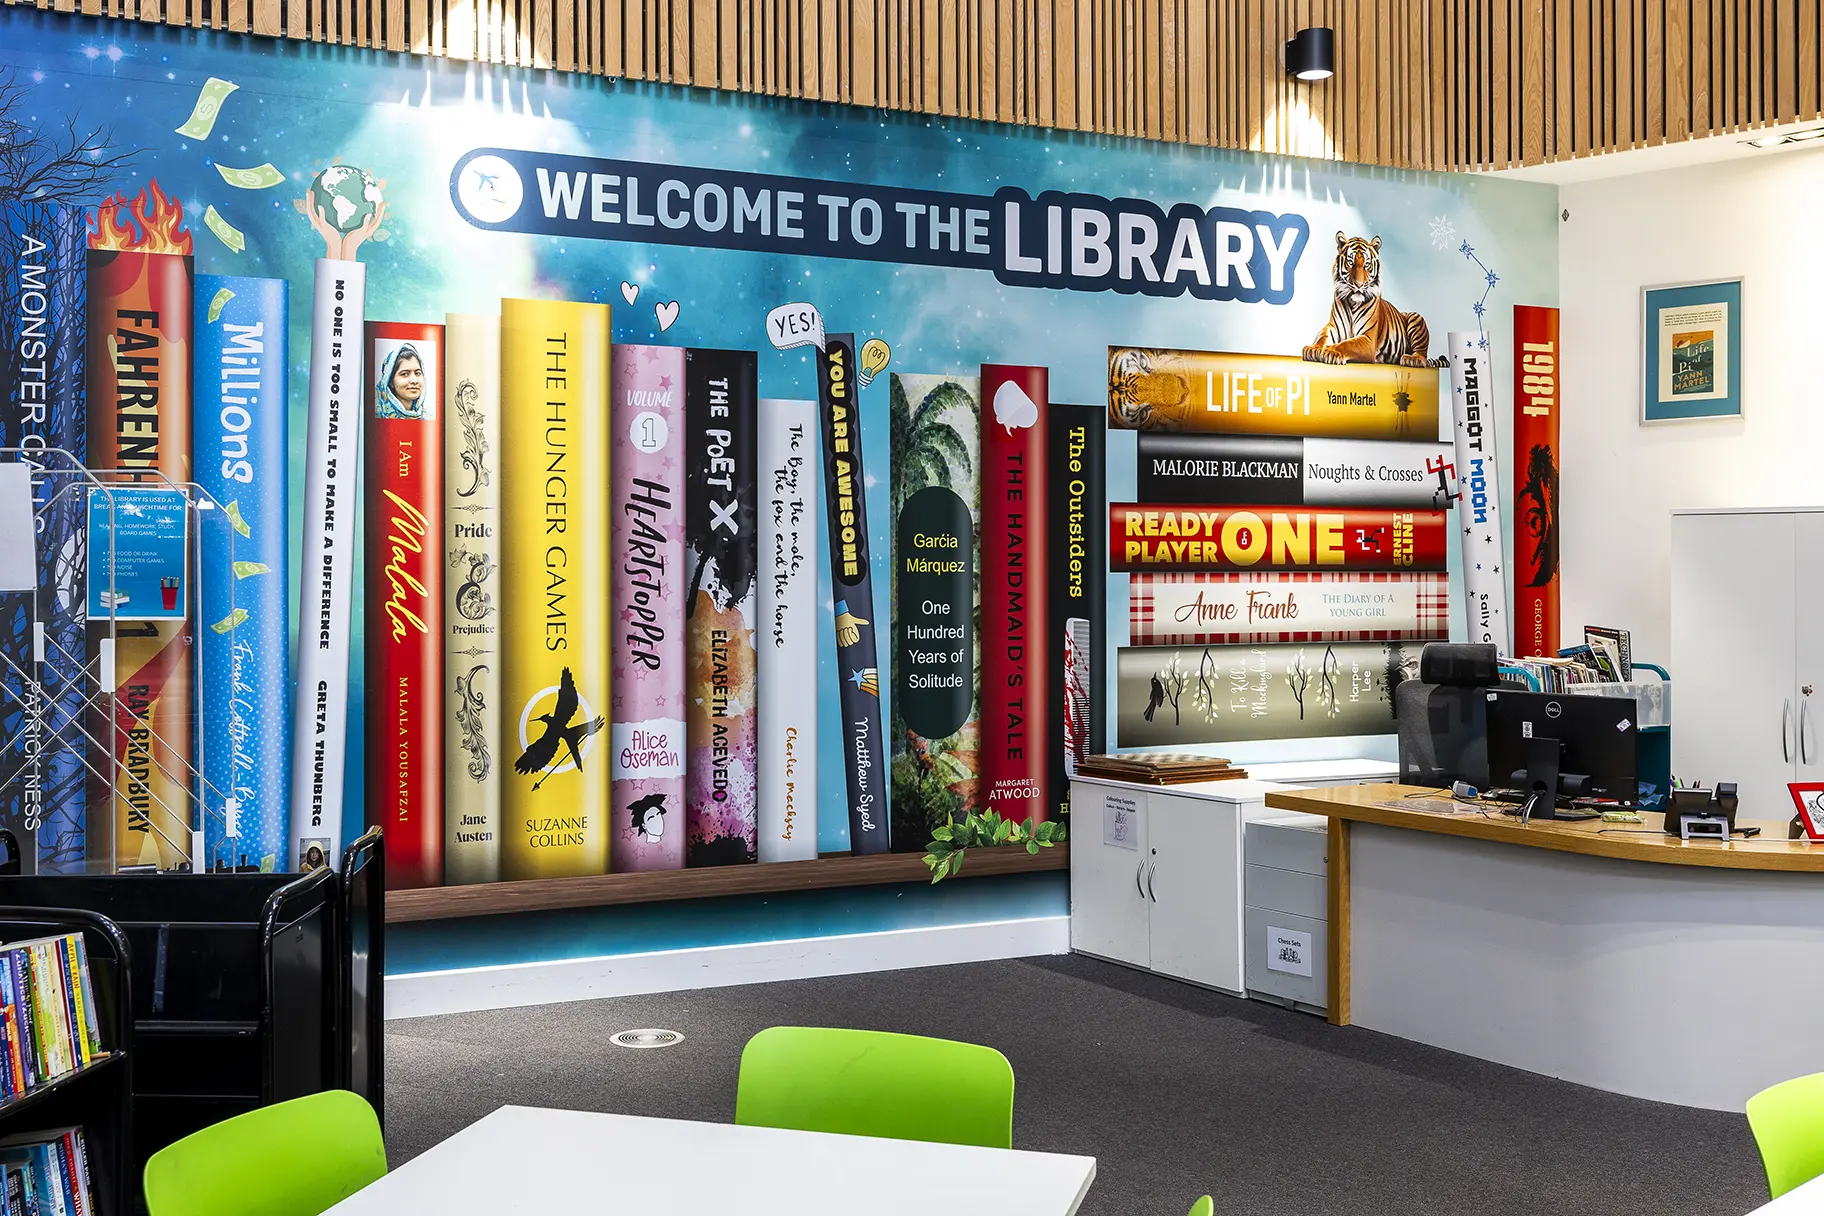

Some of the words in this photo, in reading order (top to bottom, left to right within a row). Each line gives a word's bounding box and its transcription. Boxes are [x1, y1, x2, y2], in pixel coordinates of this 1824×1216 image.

[20, 234, 46, 256] A
[536, 167, 804, 238] WELCOME
[818, 194, 882, 245] TO
[896, 202, 990, 254] THE
[1005, 201, 1299, 292] LIBRARY
[334, 279, 345, 301] NO
[332, 306, 344, 338] ONE
[775, 311, 817, 337] YES!
[20, 262, 46, 425] MONSTER
[332, 344, 342, 359] IS
[1688, 344, 1708, 358] Life
[546, 332, 567, 390] THE
[829, 348, 846, 398] YOU
[1678, 370, 1703, 382] YANN
[1680, 361, 1694, 372] Pi
[331, 364, 342, 395] TOO
[1206, 371, 1262, 414] LIFE
[1266, 386, 1283, 408] OF
[1286, 376, 1310, 416] PI
[1522, 341, 1554, 418] 1984
[1674, 376, 1710, 390] MARTEL
[116, 309, 160, 487] FAHRENH
[220, 322, 264, 484] Millions
[626, 388, 673, 408] VOLUME
[708, 378, 729, 418] THE
[1327, 390, 1348, 404] Yann
[1350, 392, 1376, 407] Martel
[1464, 358, 1482, 452] MAGGOT
[328, 400, 341, 454] SMALL
[642, 418, 656, 447] 1
[788, 423, 804, 452] The
[832, 404, 849, 453] ARE
[398, 450, 412, 478] Am
[1069, 426, 1086, 474] The
[326, 459, 338, 480] TO
[546, 402, 568, 536] HUNGER
[774, 465, 788, 494] the
[787, 457, 803, 494] Boy,
[1006, 451, 1023, 502] THE
[1152, 458, 1219, 477] MALORIE
[1222, 460, 1298, 479] BLACKMAN
[1308, 464, 1360, 483] Noughts
[1364, 465, 1376, 481] &
[1378, 466, 1424, 482] Crosses
[324, 489, 336, 532] MAKE
[708, 498, 738, 535] X
[772, 500, 784, 528] fox
[790, 497, 804, 526] the
[836, 459, 858, 576] AWESOME
[1126, 512, 1220, 537] READY
[324, 536, 334, 550] A
[454, 522, 493, 538] Pride
[1069, 480, 1086, 598] Outsiders
[1220, 512, 1346, 566] ONE
[1393, 512, 1402, 566] ERNEST
[1402, 513, 1414, 567] CLINE
[382, 489, 430, 644] Malala
[775, 533, 788, 568] and
[790, 532, 804, 576] mole,
[1125, 541, 1219, 564] PLAYER
[906, 558, 966, 576] Márquez
[546, 545, 568, 652] GAMES
[774, 570, 788, 600] the
[1371, 594, 1384, 604] OF
[1386, 594, 1394, 603] A
[319, 554, 334, 650] DIFFERENCE
[921, 600, 951, 615] One
[1174, 590, 1238, 626] Anne
[1246, 590, 1300, 623] Frank
[1330, 606, 1360, 618] YOUNG
[1362, 606, 1386, 616] GIRL
[1480, 594, 1488, 628] Sally
[452, 624, 495, 636] Prejudice
[773, 604, 788, 648] horse
[906, 624, 965, 640] Hundred
[1534, 598, 1542, 646] GEORGE
[232, 639, 255, 694] Frank
[908, 650, 947, 665] Years
[950, 649, 964, 664] of
[908, 673, 964, 689] Solitude
[1230, 666, 1250, 694] Kill
[1250, 648, 1272, 719] Mockingbird
[1350, 660, 1362, 702] Harper
[1362, 670, 1372, 692] Lee
[128, 684, 150, 722] RAY
[315, 680, 328, 736] GRETA
[399, 677, 408, 734] MALALA
[1230, 696, 1248, 712] To
[24, 681, 42, 768] PATRICK
[631, 730, 668, 750] Alice
[1007, 698, 1023, 761] TALE
[620, 747, 680, 770] Oseman
[712, 724, 728, 803] ACEVEDO
[786, 727, 798, 778] Charlie
[855, 716, 872, 792] Matthew
[128, 728, 150, 834] BRADBURY
[312, 740, 326, 828] THUNBERG
[399, 742, 408, 822] YOUSAFZAI
[989, 786, 1040, 800] ATWOOD
[995, 778, 1034, 788] MARGARET
[24, 774, 42, 831] NESS
[856, 794, 876, 832] Syed
[460, 814, 487, 826] Jane
[526, 816, 588, 832] SUZANNE
[454, 830, 493, 844] Austen
[530, 832, 585, 848] COLLINS
[1278, 938, 1290, 946] Chess
[71, 972, 80, 989] RAIN
[58, 1143, 68, 1175] NISHA'S
[80, 1138, 88, 1166] KILLER
